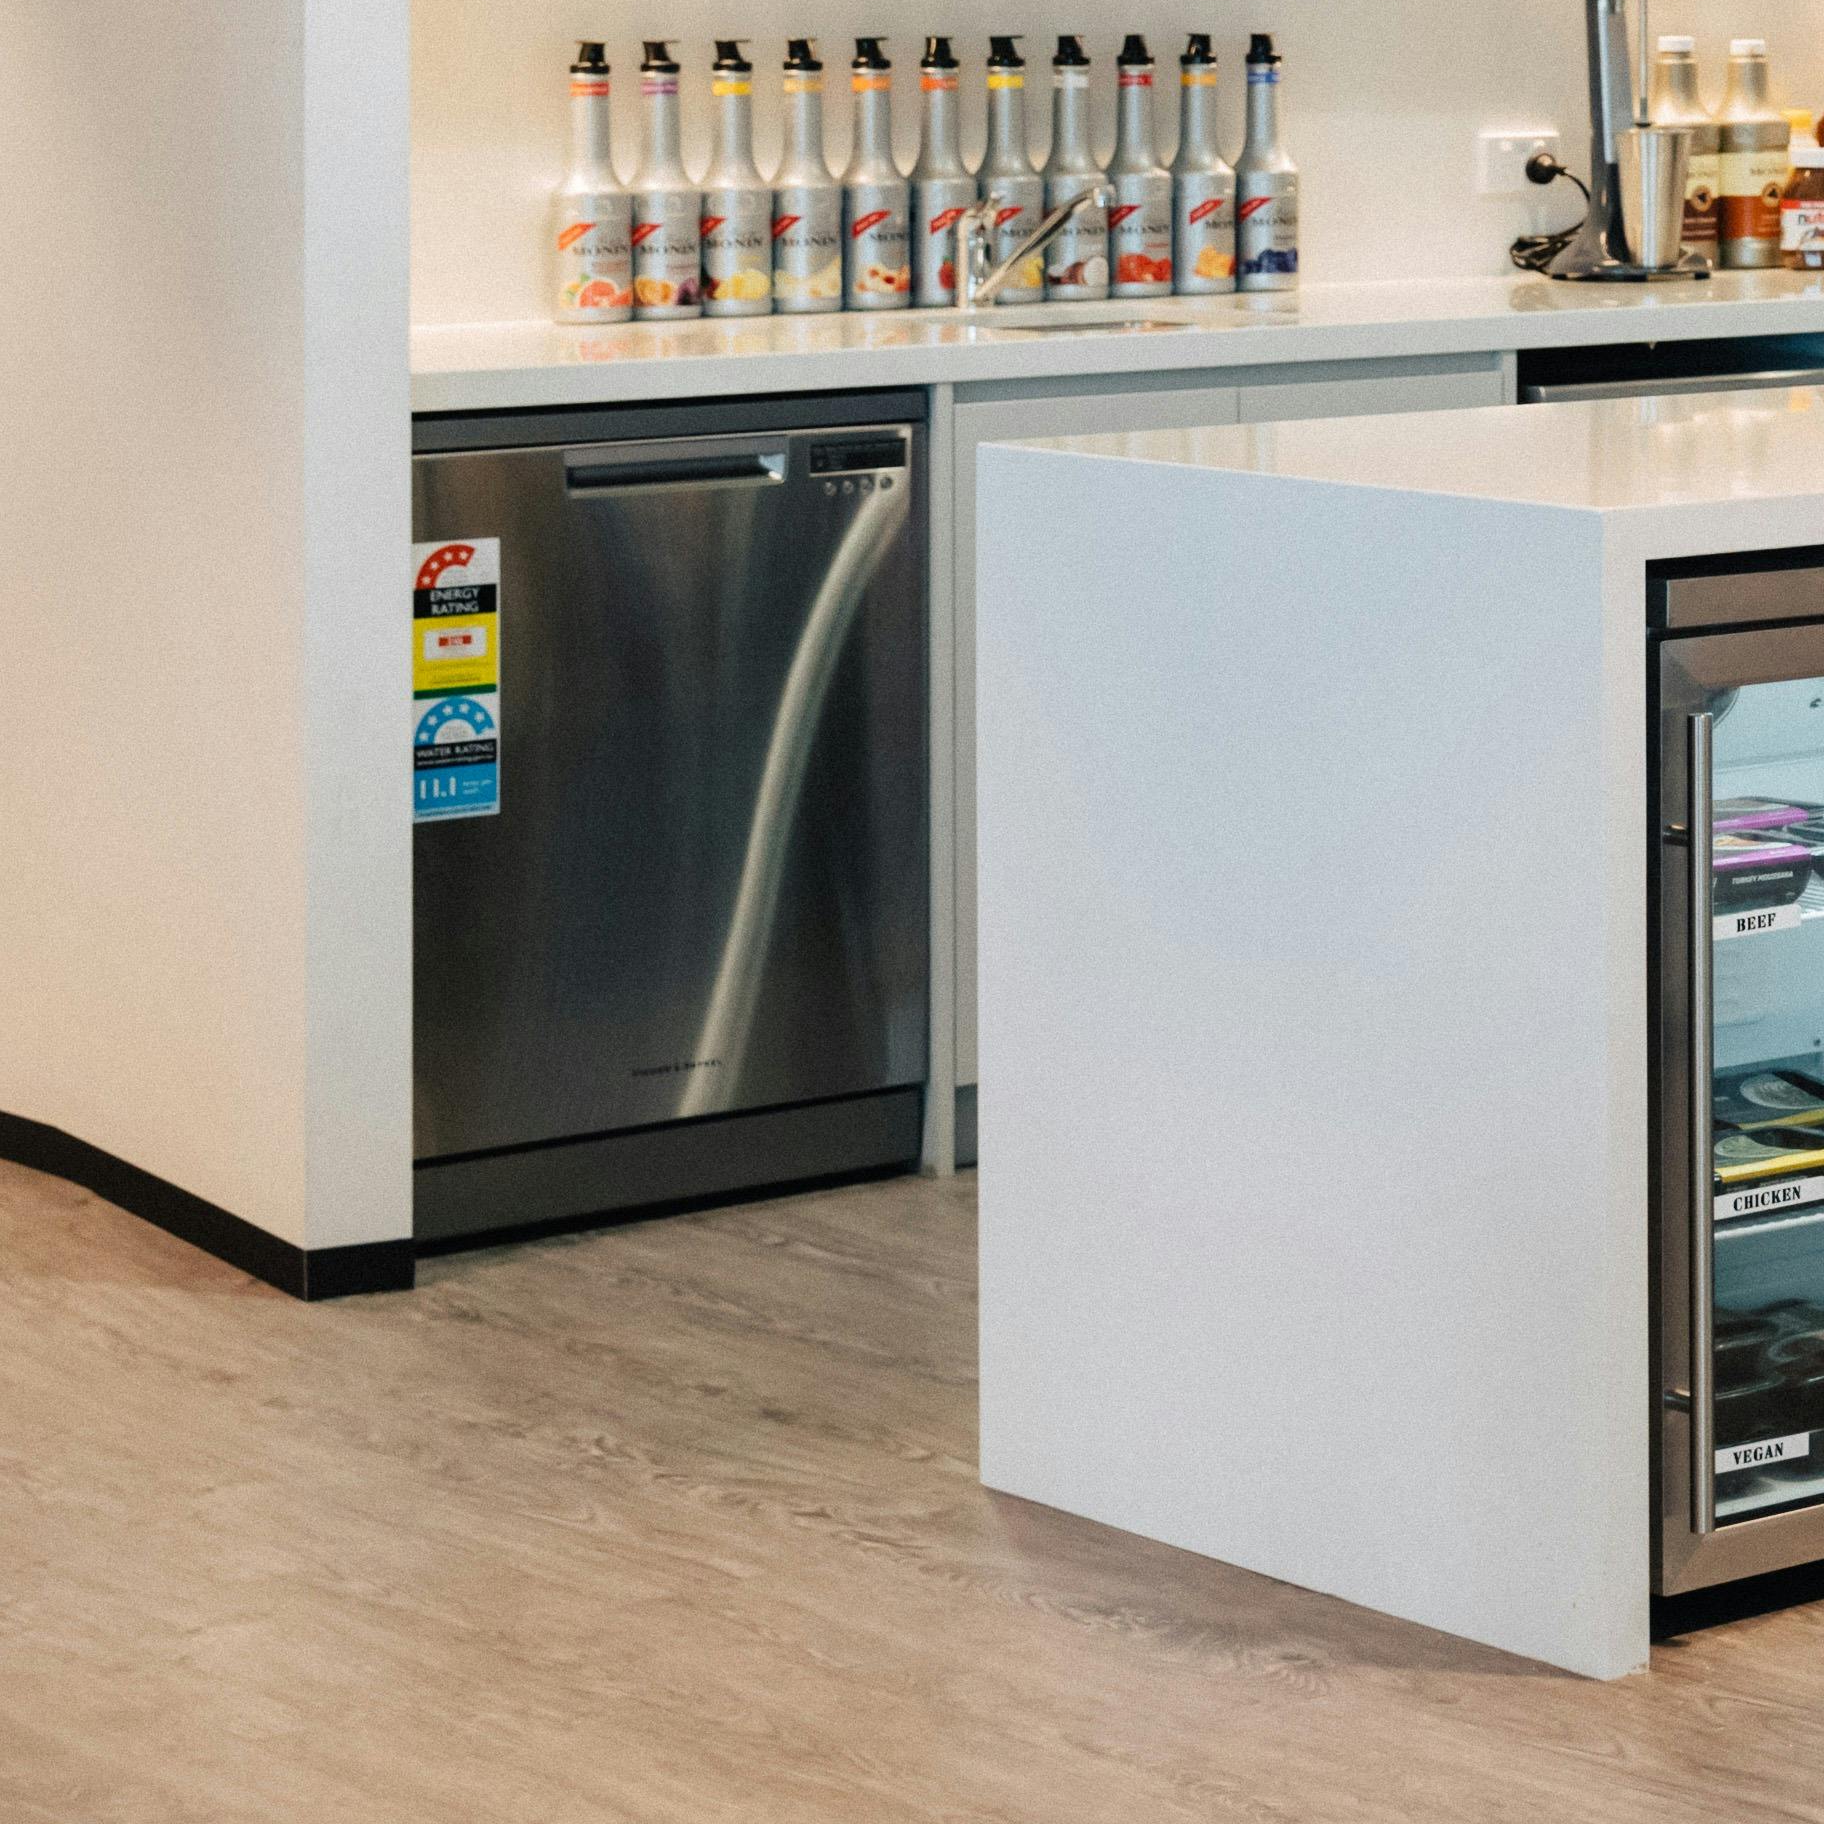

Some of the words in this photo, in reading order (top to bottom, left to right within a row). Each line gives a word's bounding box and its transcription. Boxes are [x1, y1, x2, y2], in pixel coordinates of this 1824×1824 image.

[430, 587, 479, 602] ENERGY
[432, 602, 479, 615] RATING
[420, 777, 456, 800] 11.1
[1736, 913, 1777, 933] BEEF
[1733, 1185, 1801, 1212] CHICKEN
[1733, 1442, 1785, 1465] VEGAN
